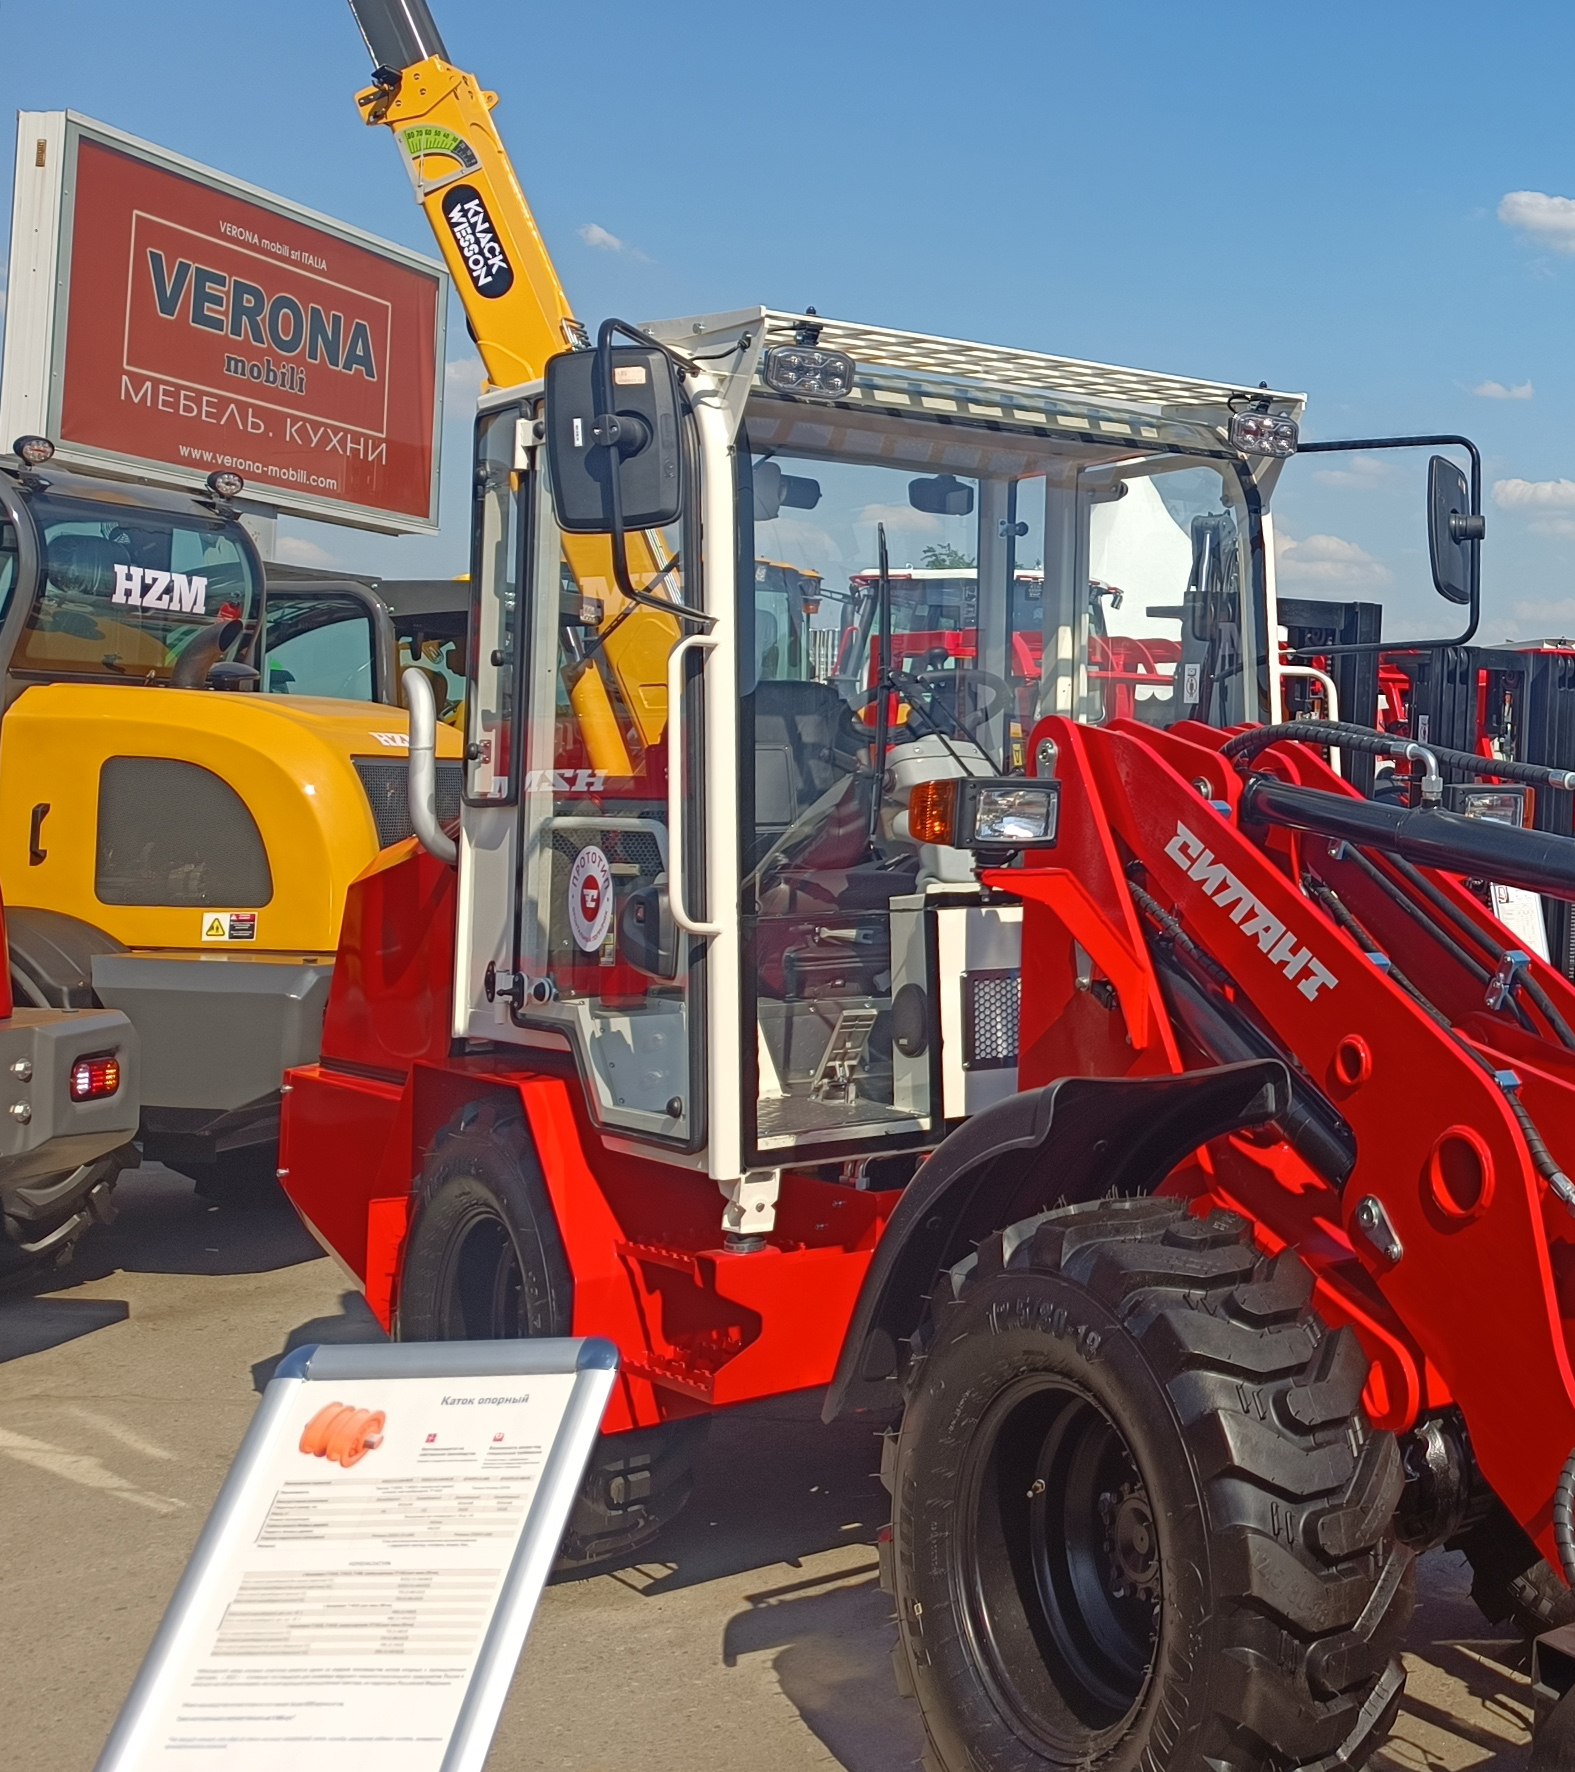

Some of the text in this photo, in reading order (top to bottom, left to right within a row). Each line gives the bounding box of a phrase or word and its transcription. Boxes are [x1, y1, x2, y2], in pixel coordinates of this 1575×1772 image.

[219, 220, 259, 246] VERONA
[261, 237, 289, 257] mobili
[301, 249, 327, 271] ITALIA
[448, 203, 493, 287] WESSON
[463, 199, 508, 275] KNACK
[147, 247, 377, 381] VERONA
[224, 352, 306, 396] mobili
[120, 374, 386, 465] МЕБЕЛЬ. КУХНИ
[179, 444, 337, 491] www.verona-mobili.com
[112, 564, 207, 614] HZM
[571, 851, 611, 890] ПРОТОТИП
[1163, 820, 1339, 1002] СИЛАНТ
